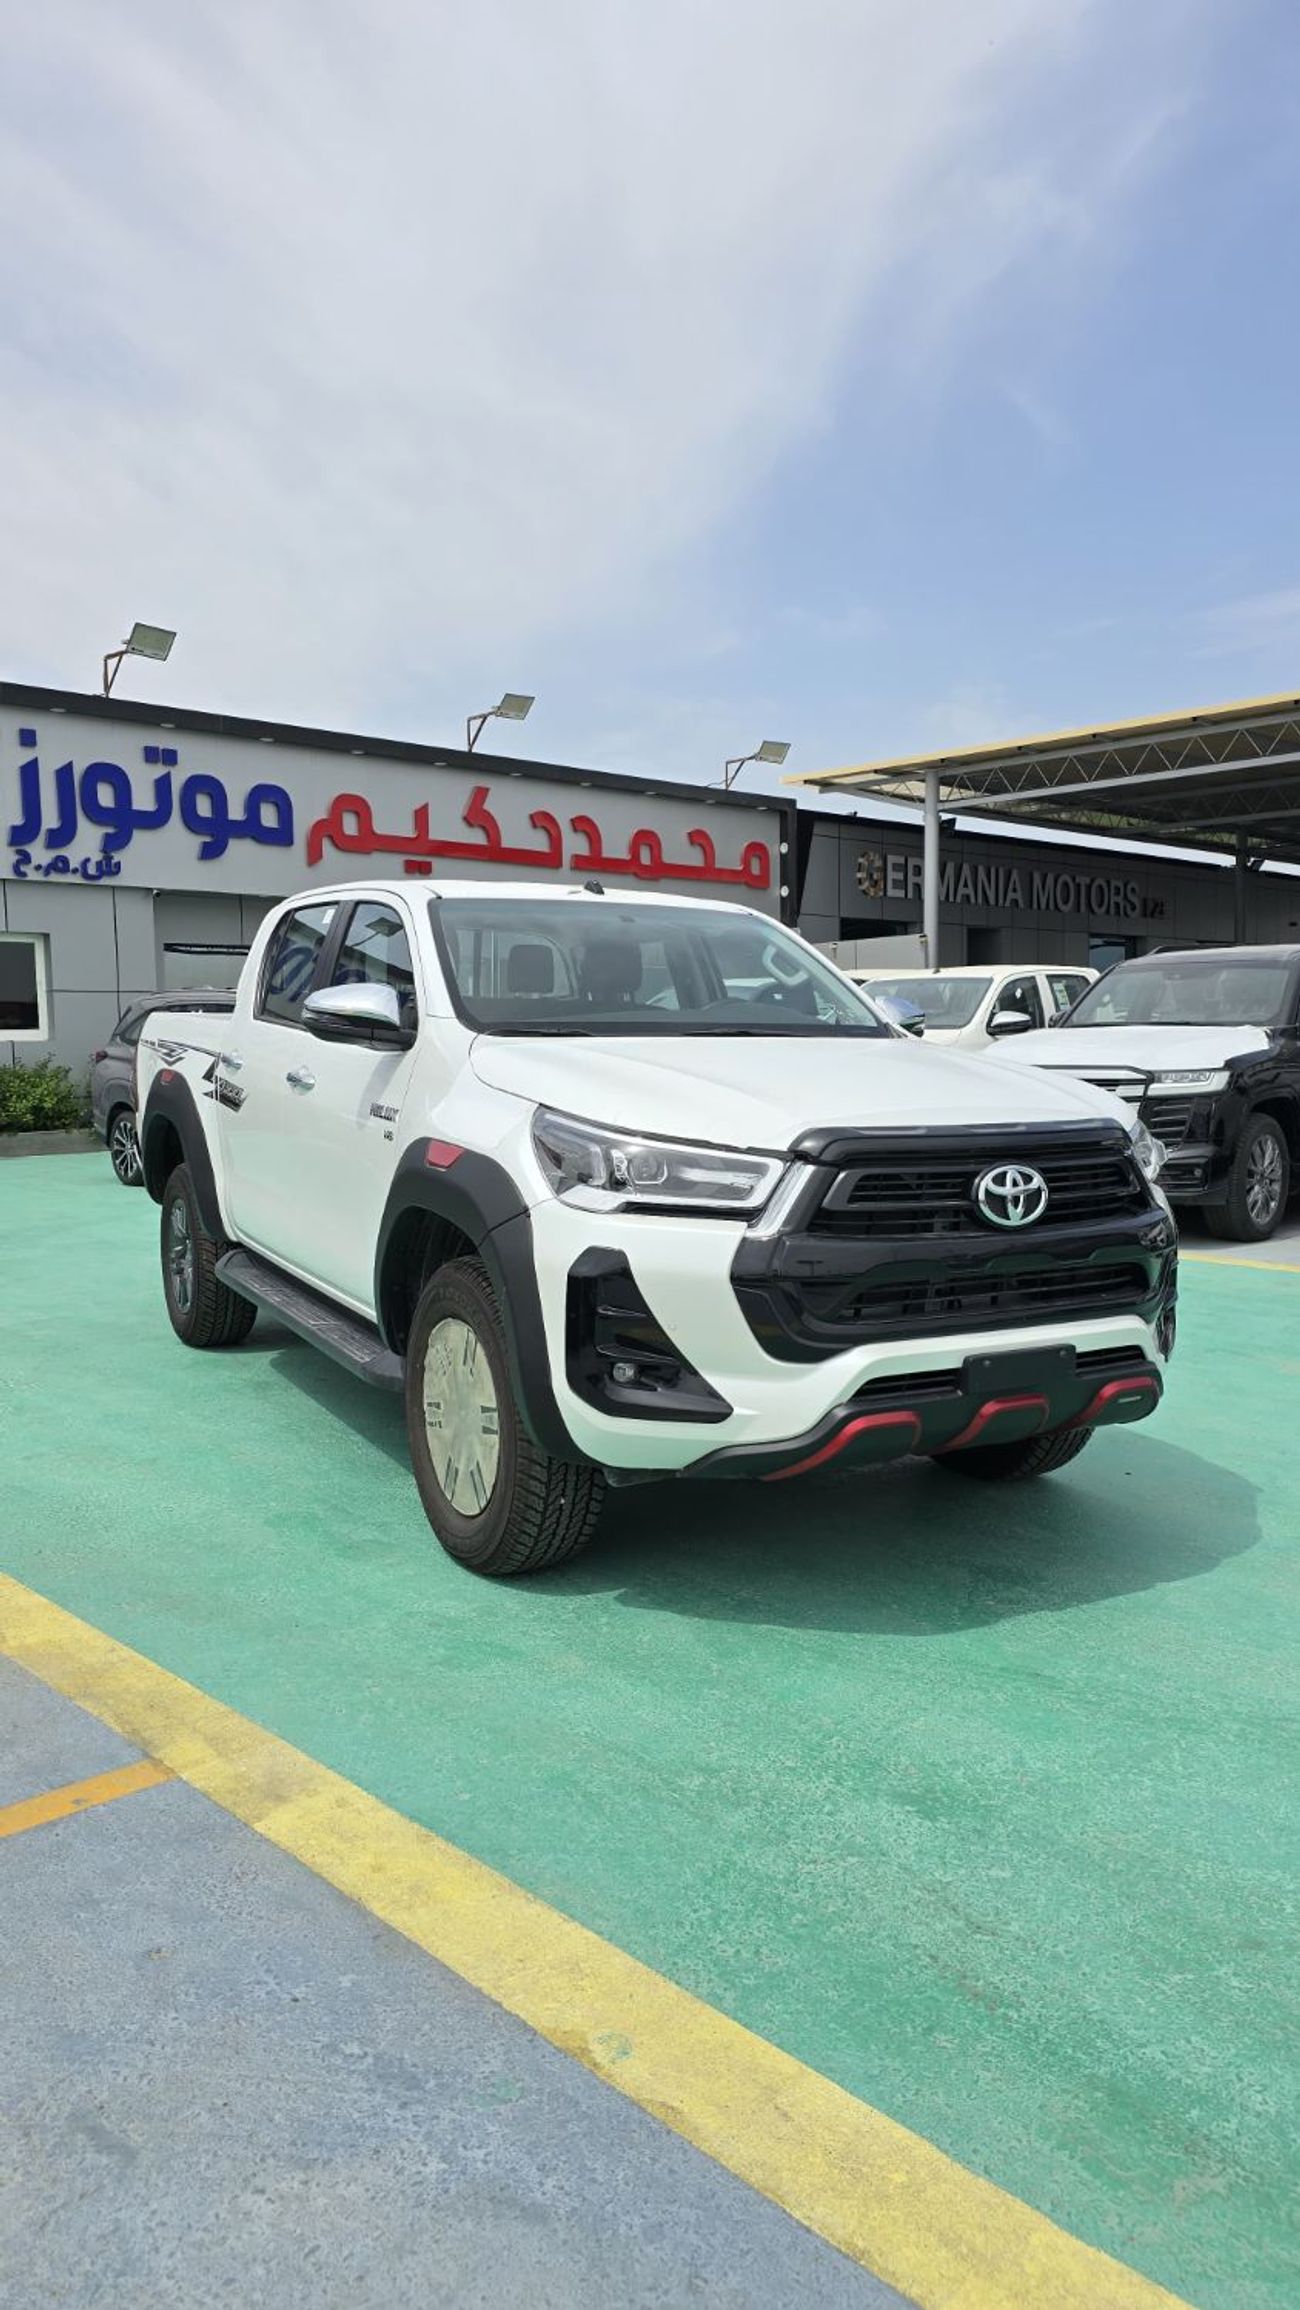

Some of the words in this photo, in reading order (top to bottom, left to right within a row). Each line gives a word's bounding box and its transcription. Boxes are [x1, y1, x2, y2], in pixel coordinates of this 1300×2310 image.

[7, 728, 294, 861] موتورز
[307, 786, 562, 875] حكيم
[570, 815, 770, 888] محمد
[1032, 871, 1140, 918] MOTORS
